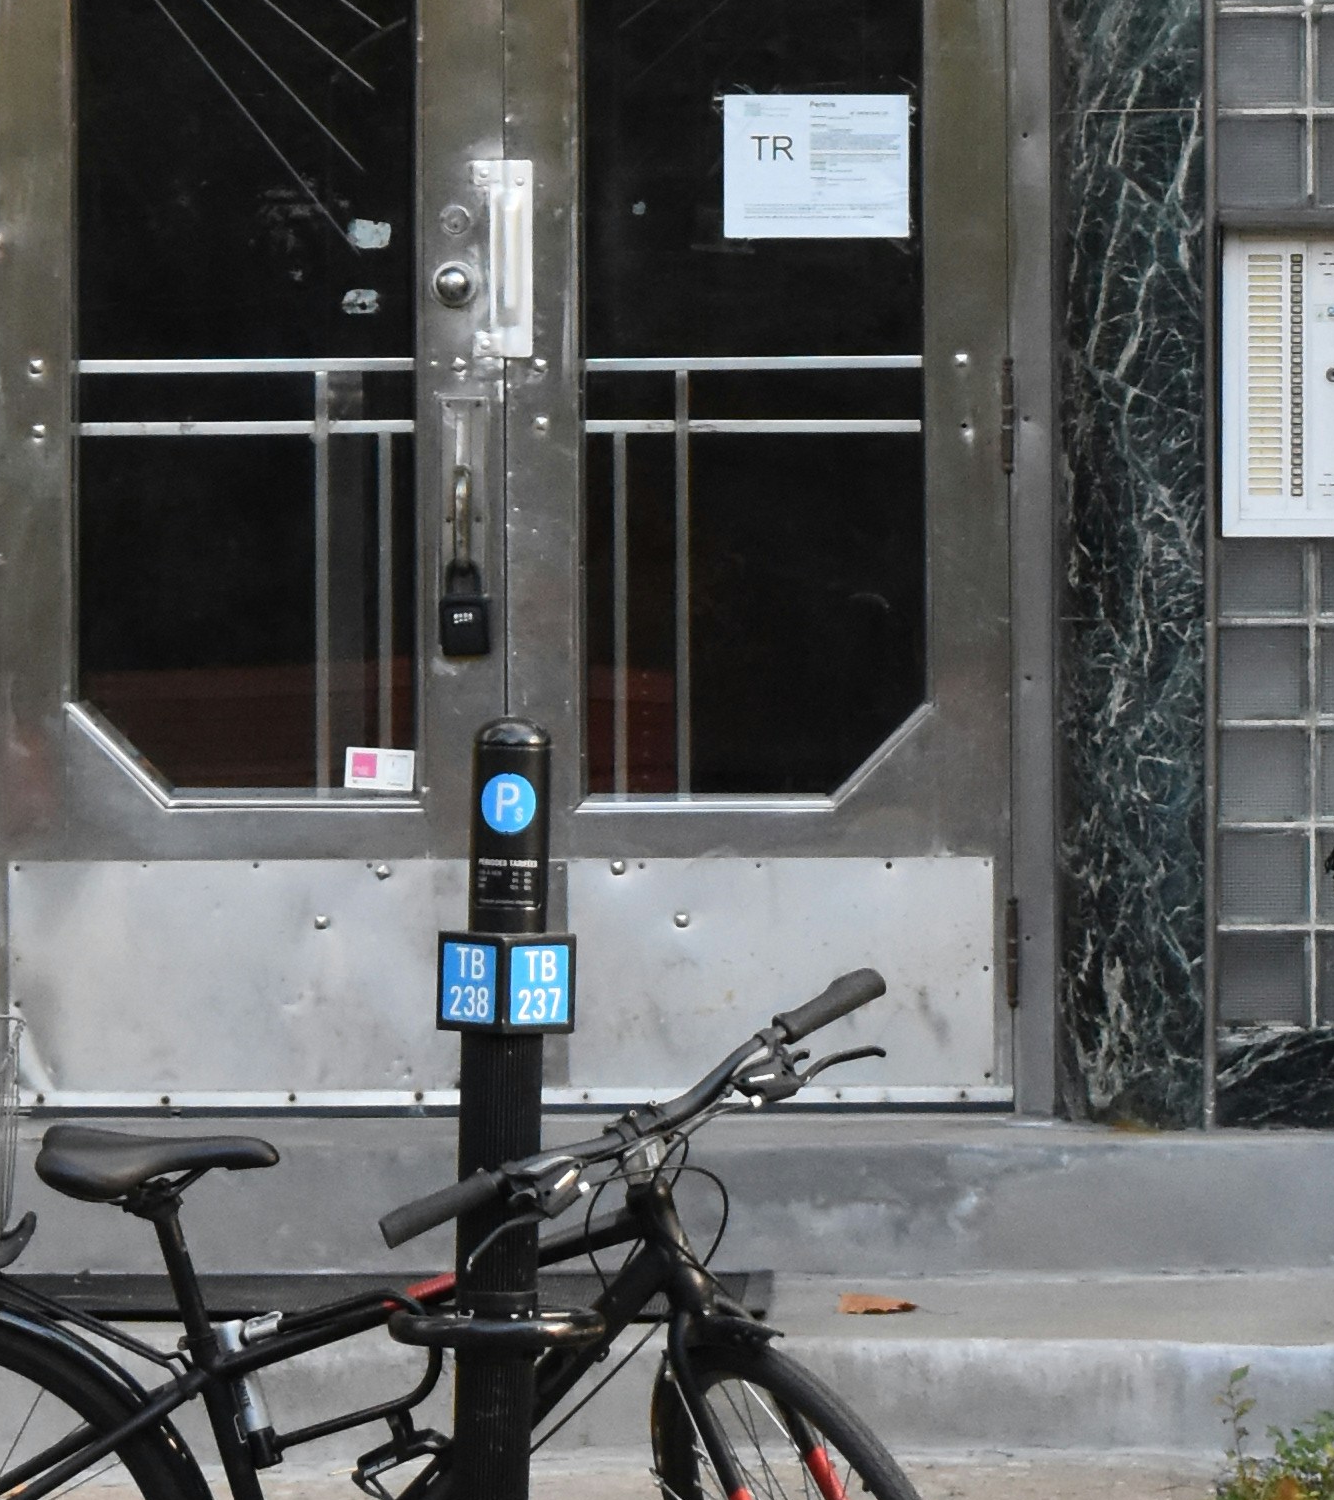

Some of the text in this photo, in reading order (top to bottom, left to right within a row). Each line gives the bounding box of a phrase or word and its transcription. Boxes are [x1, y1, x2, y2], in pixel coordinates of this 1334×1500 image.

[750, 135, 794, 161] TR
[456, 947, 485, 980] TB
[525, 950, 557, 982] TB
[449, 986, 489, 1018] 238
[517, 988, 562, 1020] 237
